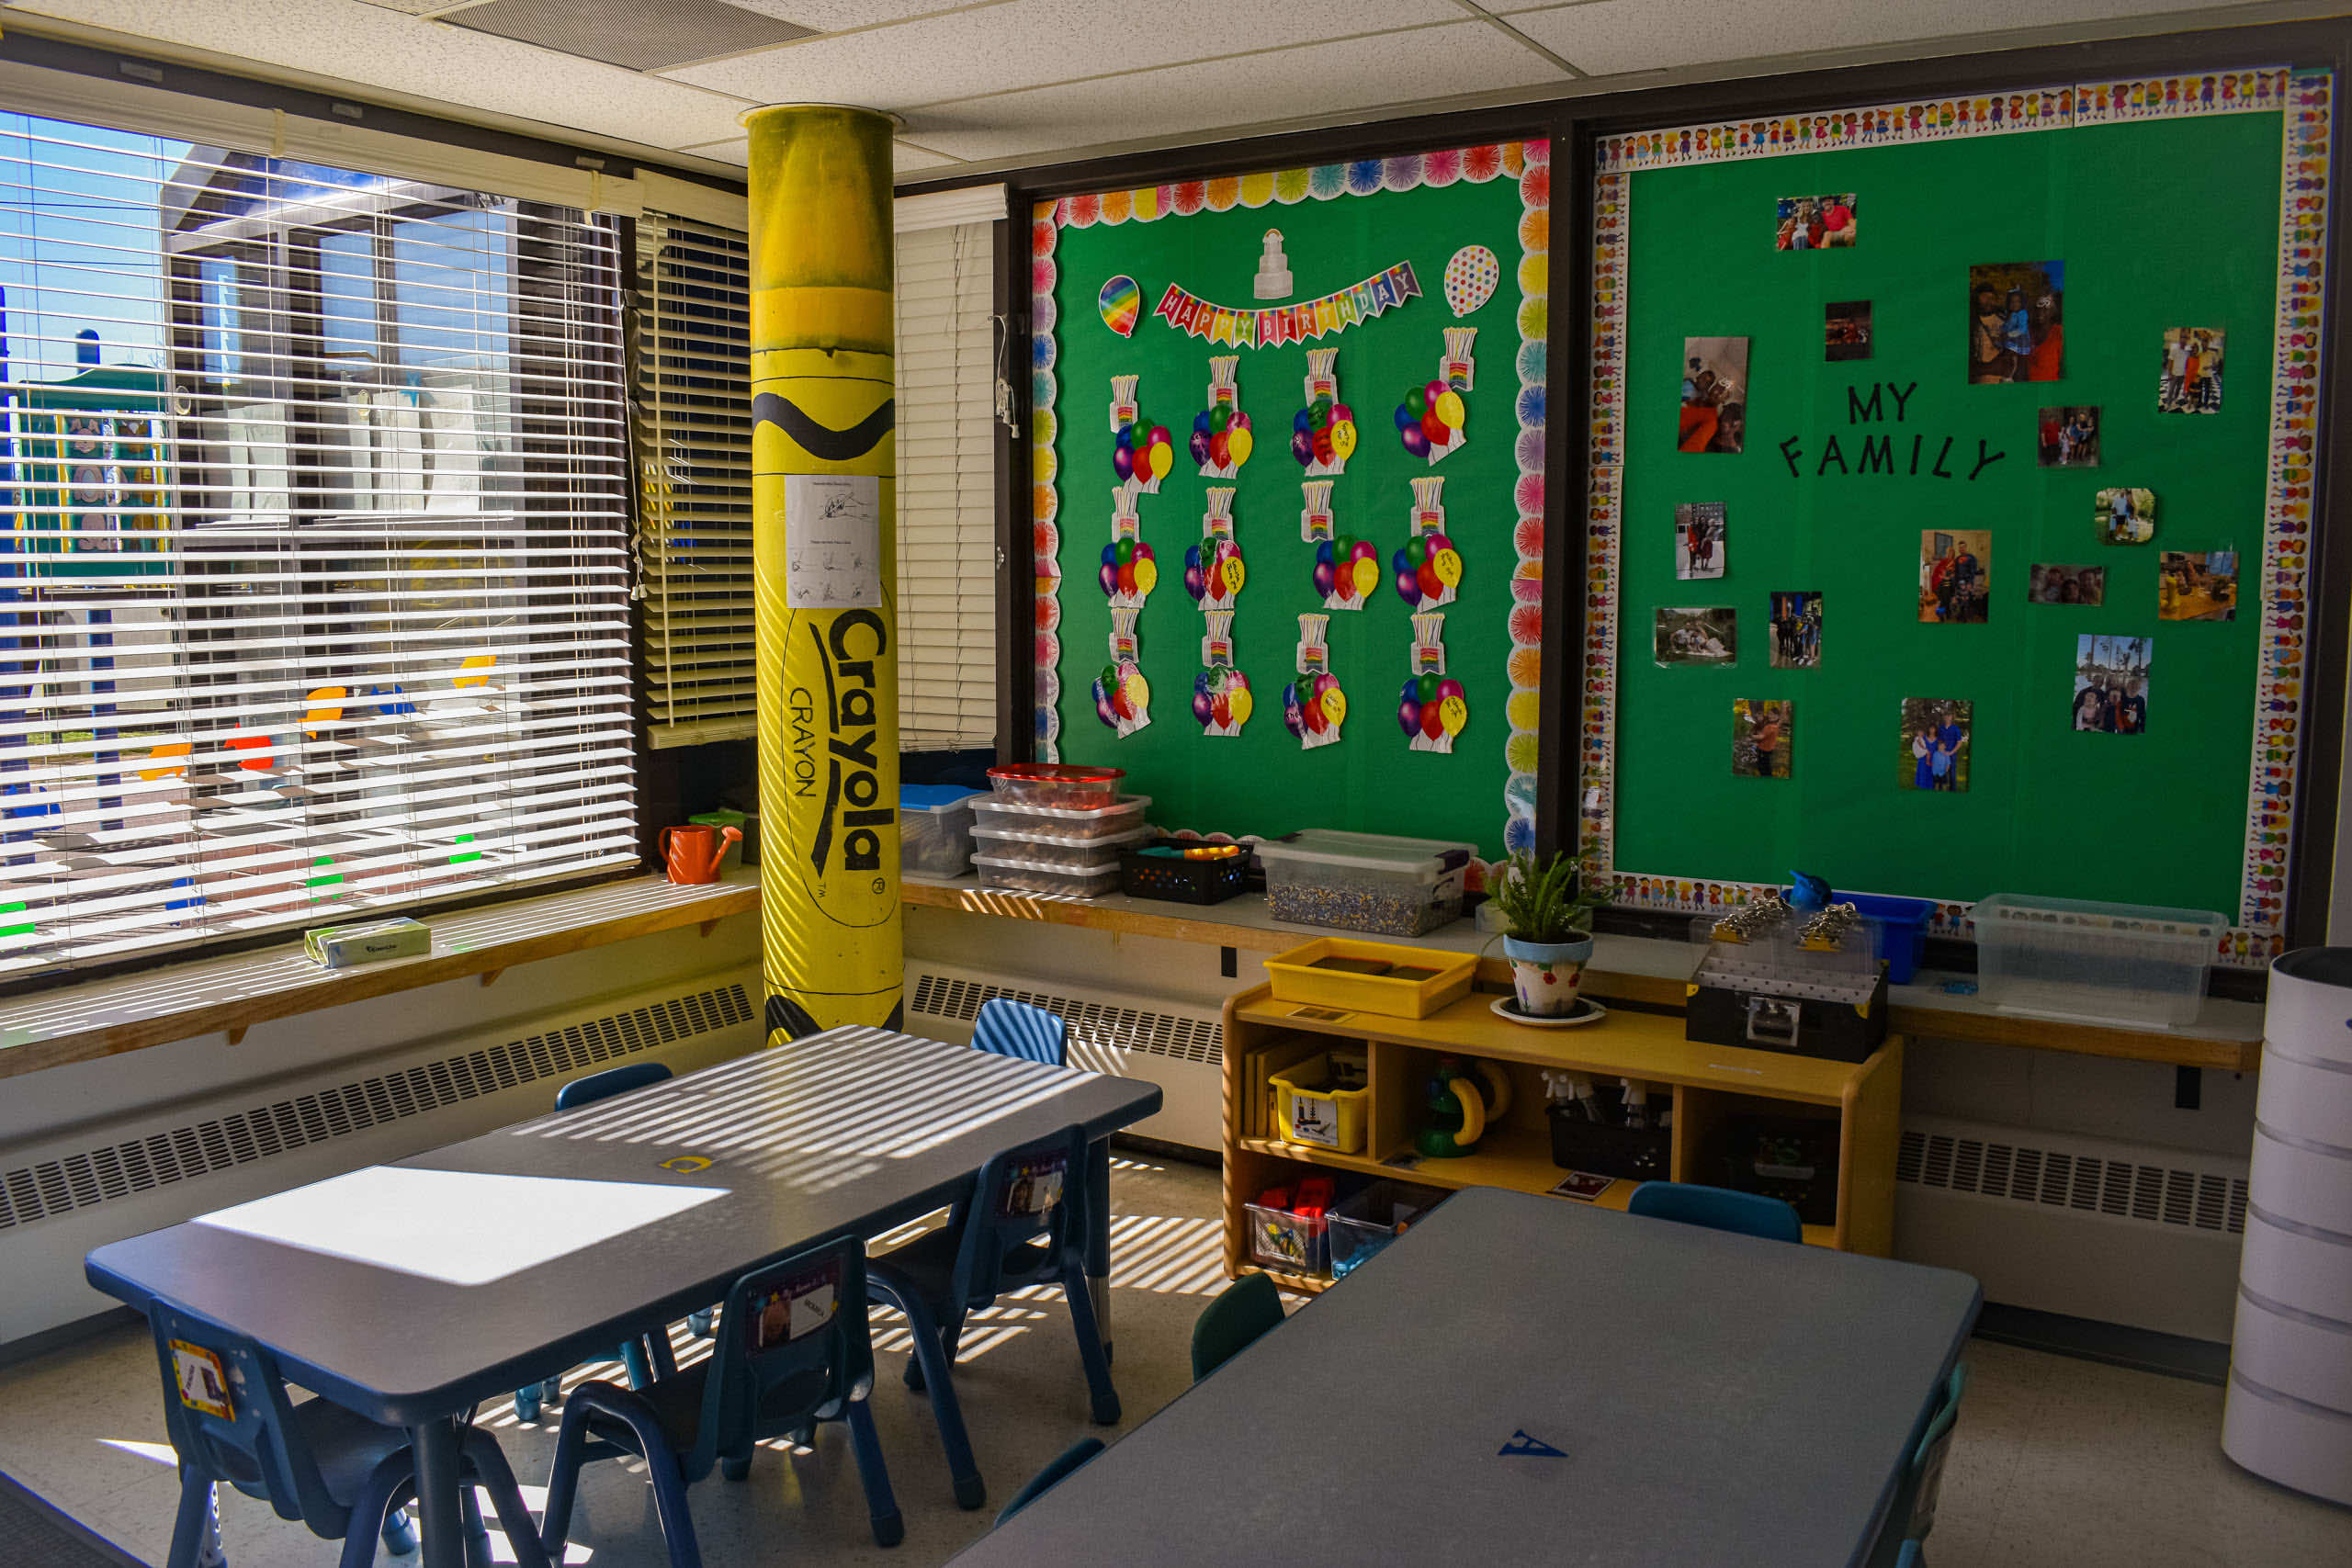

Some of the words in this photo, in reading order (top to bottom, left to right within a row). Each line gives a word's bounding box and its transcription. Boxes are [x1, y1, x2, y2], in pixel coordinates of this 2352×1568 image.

[1164, 294, 1250, 336] HAPPY
[1263, 274, 1410, 334] BIRTHDAY
[1848, 382, 1917, 424] MY
[1780, 434, 2006, 480] FAMILY
[790, 687, 817, 797] CRAYON
[829, 609, 894, 871] Crayola
[1498, 1429, 1569, 1457] A
